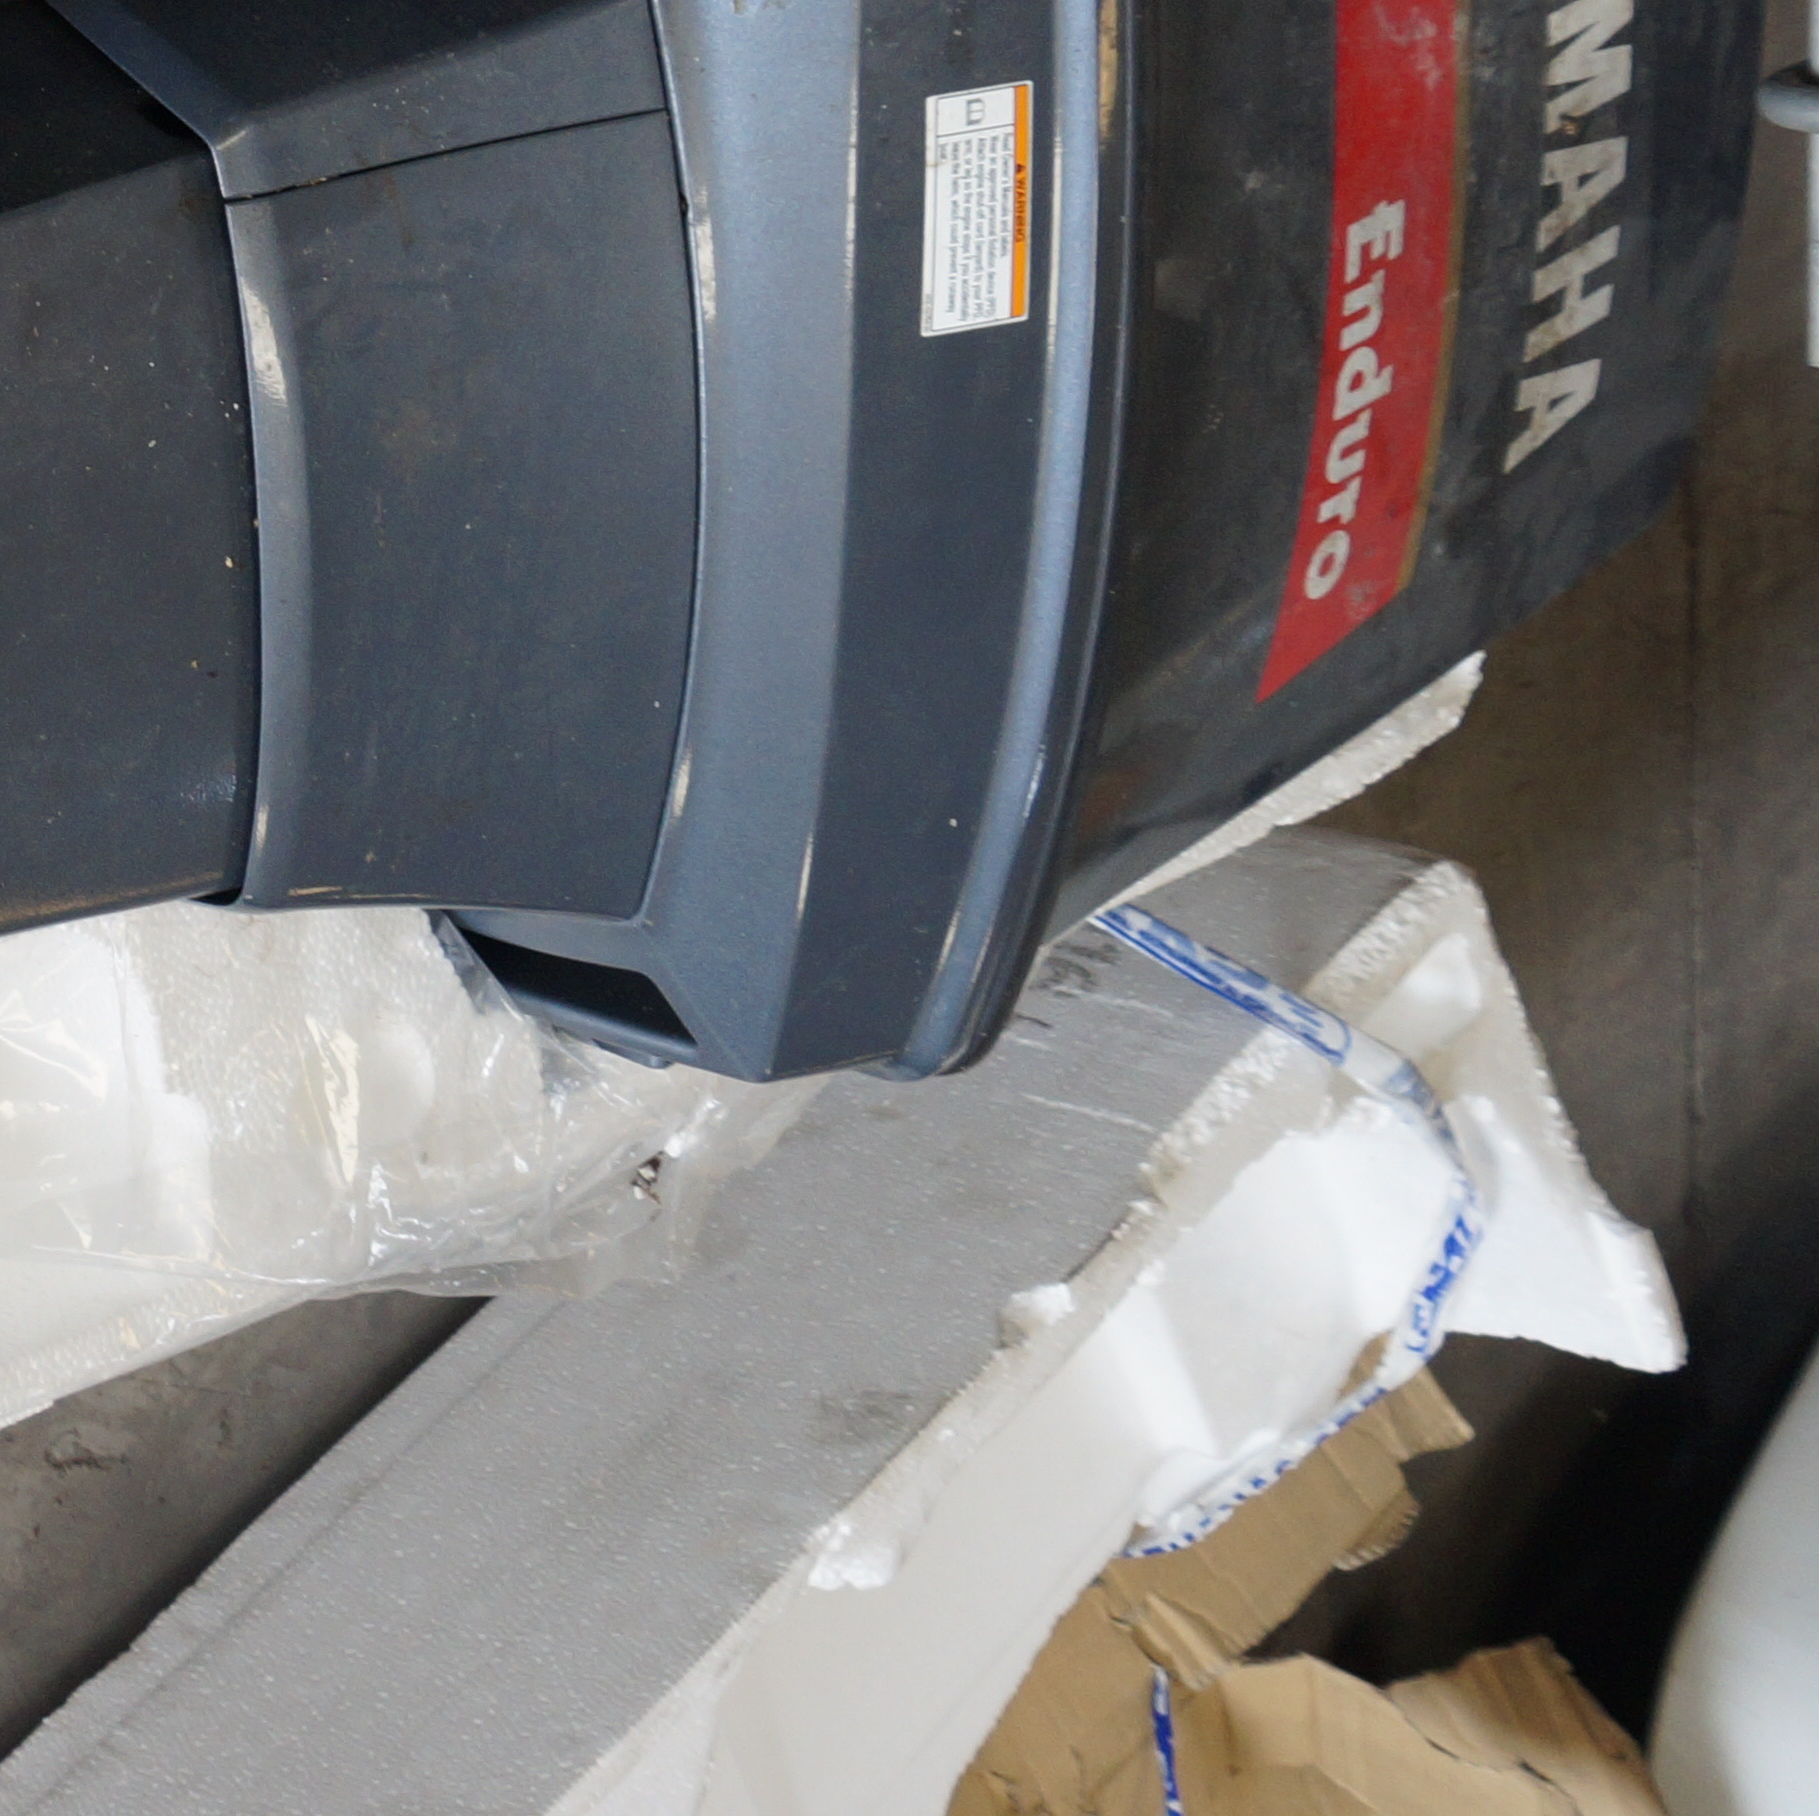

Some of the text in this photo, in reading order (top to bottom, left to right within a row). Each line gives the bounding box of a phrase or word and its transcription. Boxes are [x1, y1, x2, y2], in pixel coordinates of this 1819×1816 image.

[985, 168, 997, 202] approved
[1014, 176, 1026, 242] WARNING
[985, 204, 996, 236] personal
[1303, 198, 1406, 602] Enduro
